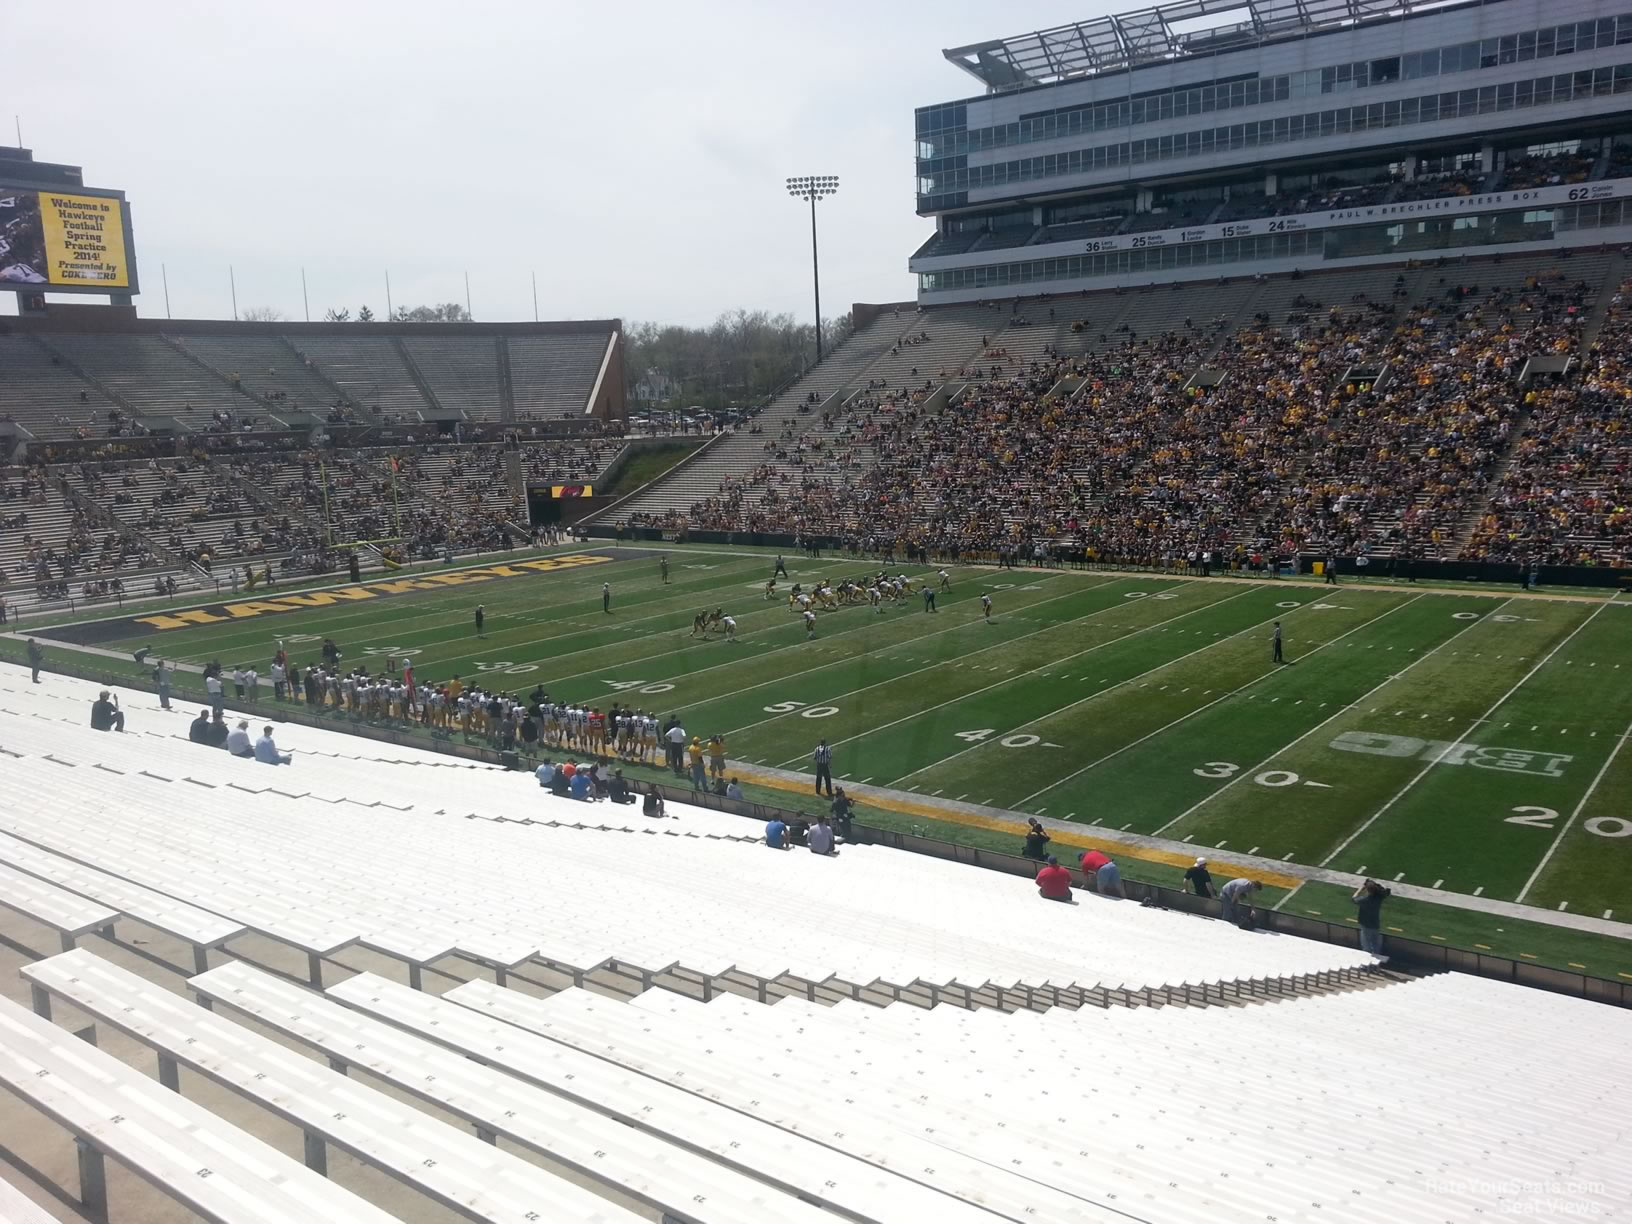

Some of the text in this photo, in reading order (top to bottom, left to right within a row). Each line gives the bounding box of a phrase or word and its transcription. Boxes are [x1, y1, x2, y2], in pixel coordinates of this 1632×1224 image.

[1569, 188, 1589, 200] 62
[51, 198, 110, 212] Welcome to
[1330, 210, 1361, 220] PAUL
[1459, 195, 1503, 206] PRESS
[1512, 192, 1540, 201] BOX
[58, 209, 105, 222] Hawkeye
[62, 220, 104, 232] Football
[1222, 226, 1235, 237] 15
[1268, 220, 1285, 232] 24
[66, 230, 102, 242] Spring
[1132, 236, 1146, 248] 25
[1181, 231, 1186, 241] 1
[64, 240, 107, 252] Practice
[1086, 241, 1100, 252] 36
[58, 260, 117, 272] Presented by
[133, 554, 614, 631] HAWKEYES
[476, 662, 540, 674] 30
[604, 680, 676, 694] 40
[763, 701, 840, 718] 50
[953, 728, 1042, 748] 40
[1193, 762, 1300, 788] 30
[1503, 806, 1632, 838] 20
